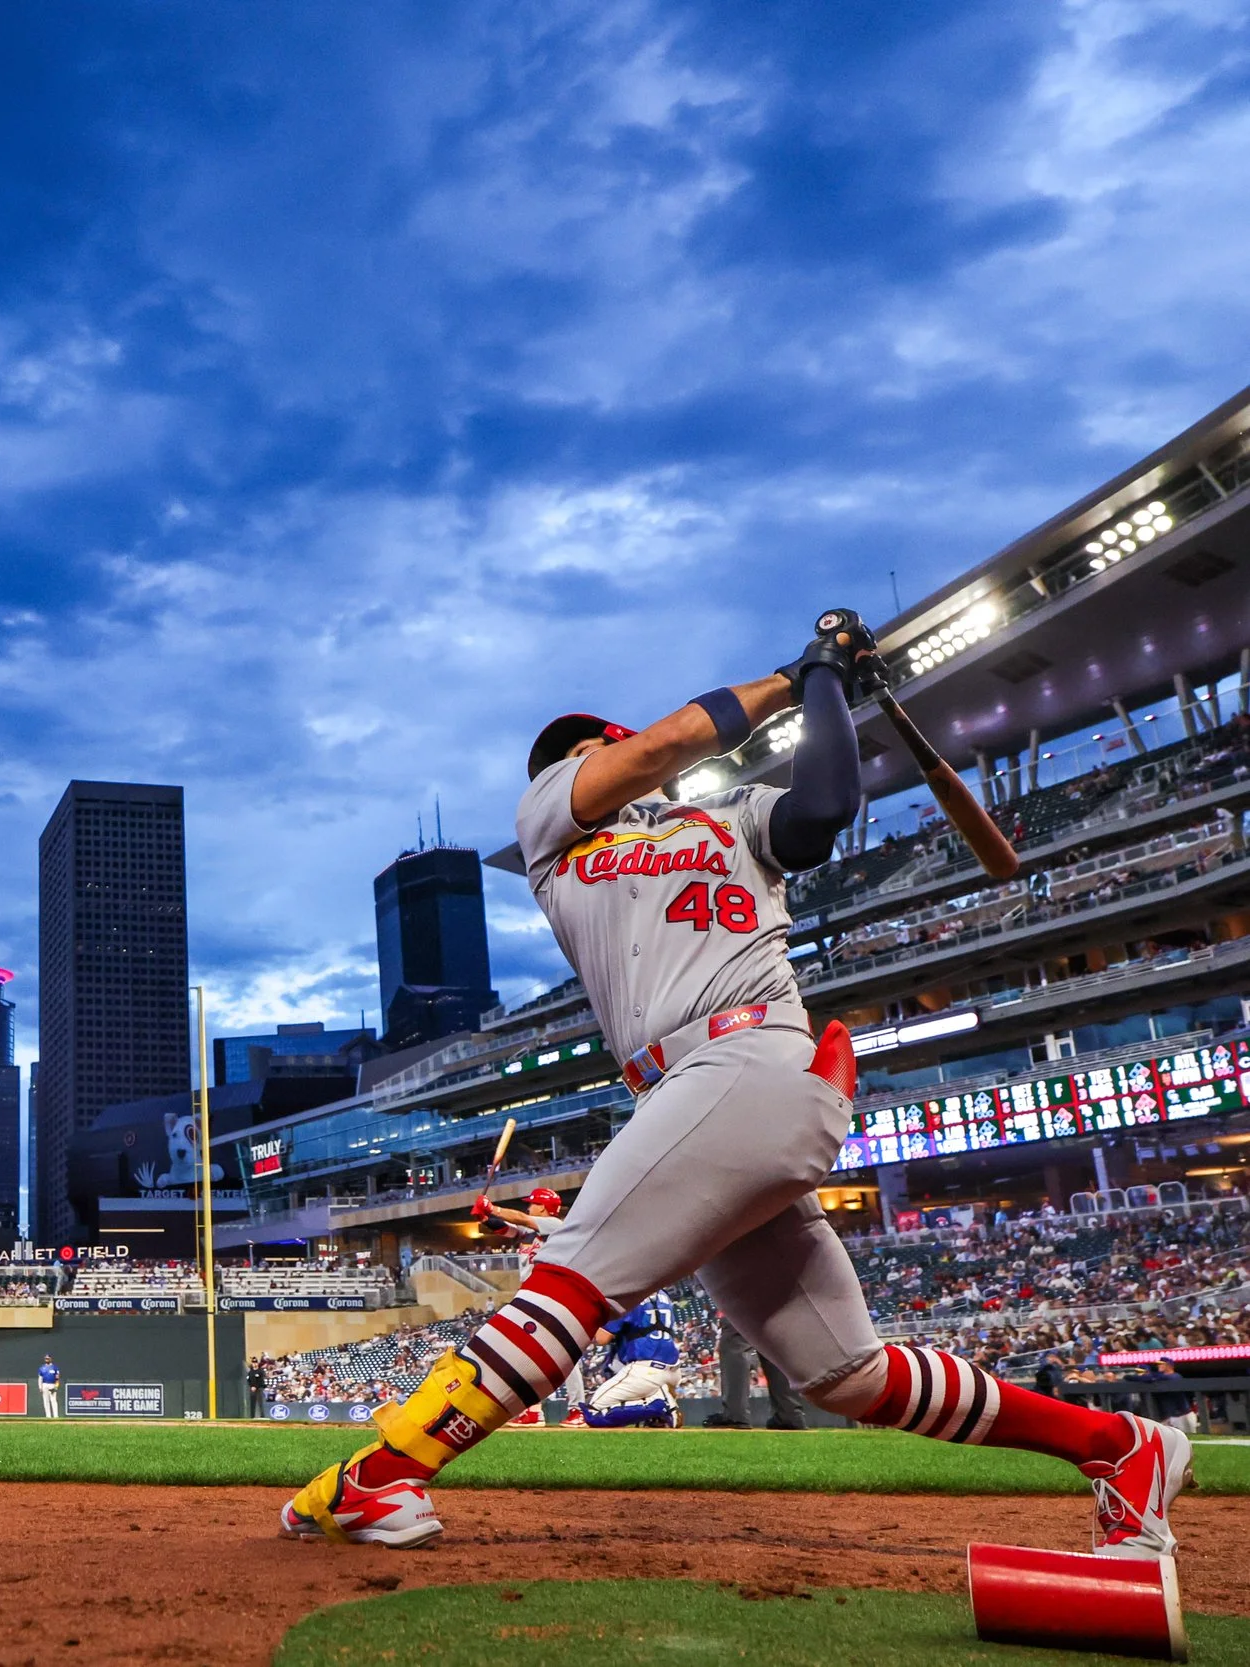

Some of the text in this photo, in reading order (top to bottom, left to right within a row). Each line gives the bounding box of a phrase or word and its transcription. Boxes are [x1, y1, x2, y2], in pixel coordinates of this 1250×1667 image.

[556, 831, 733, 886] Cardinals
[665, 881, 760, 934] 48
[251, 1139, 281, 1161] TRULY
[139, 1188, 248, 1199] TARGET ENTER
[77, 1245, 129, 1260] FIELD
[55, 1297, 175, 1311] Corona Corona Corona
[220, 1297, 364, 1310] Corona Corona Corona
[112, 1388, 160, 1400] CHANGING
[114, 1400, 160, 1411] THE GAME
[184, 1411, 203, 1419] 328
